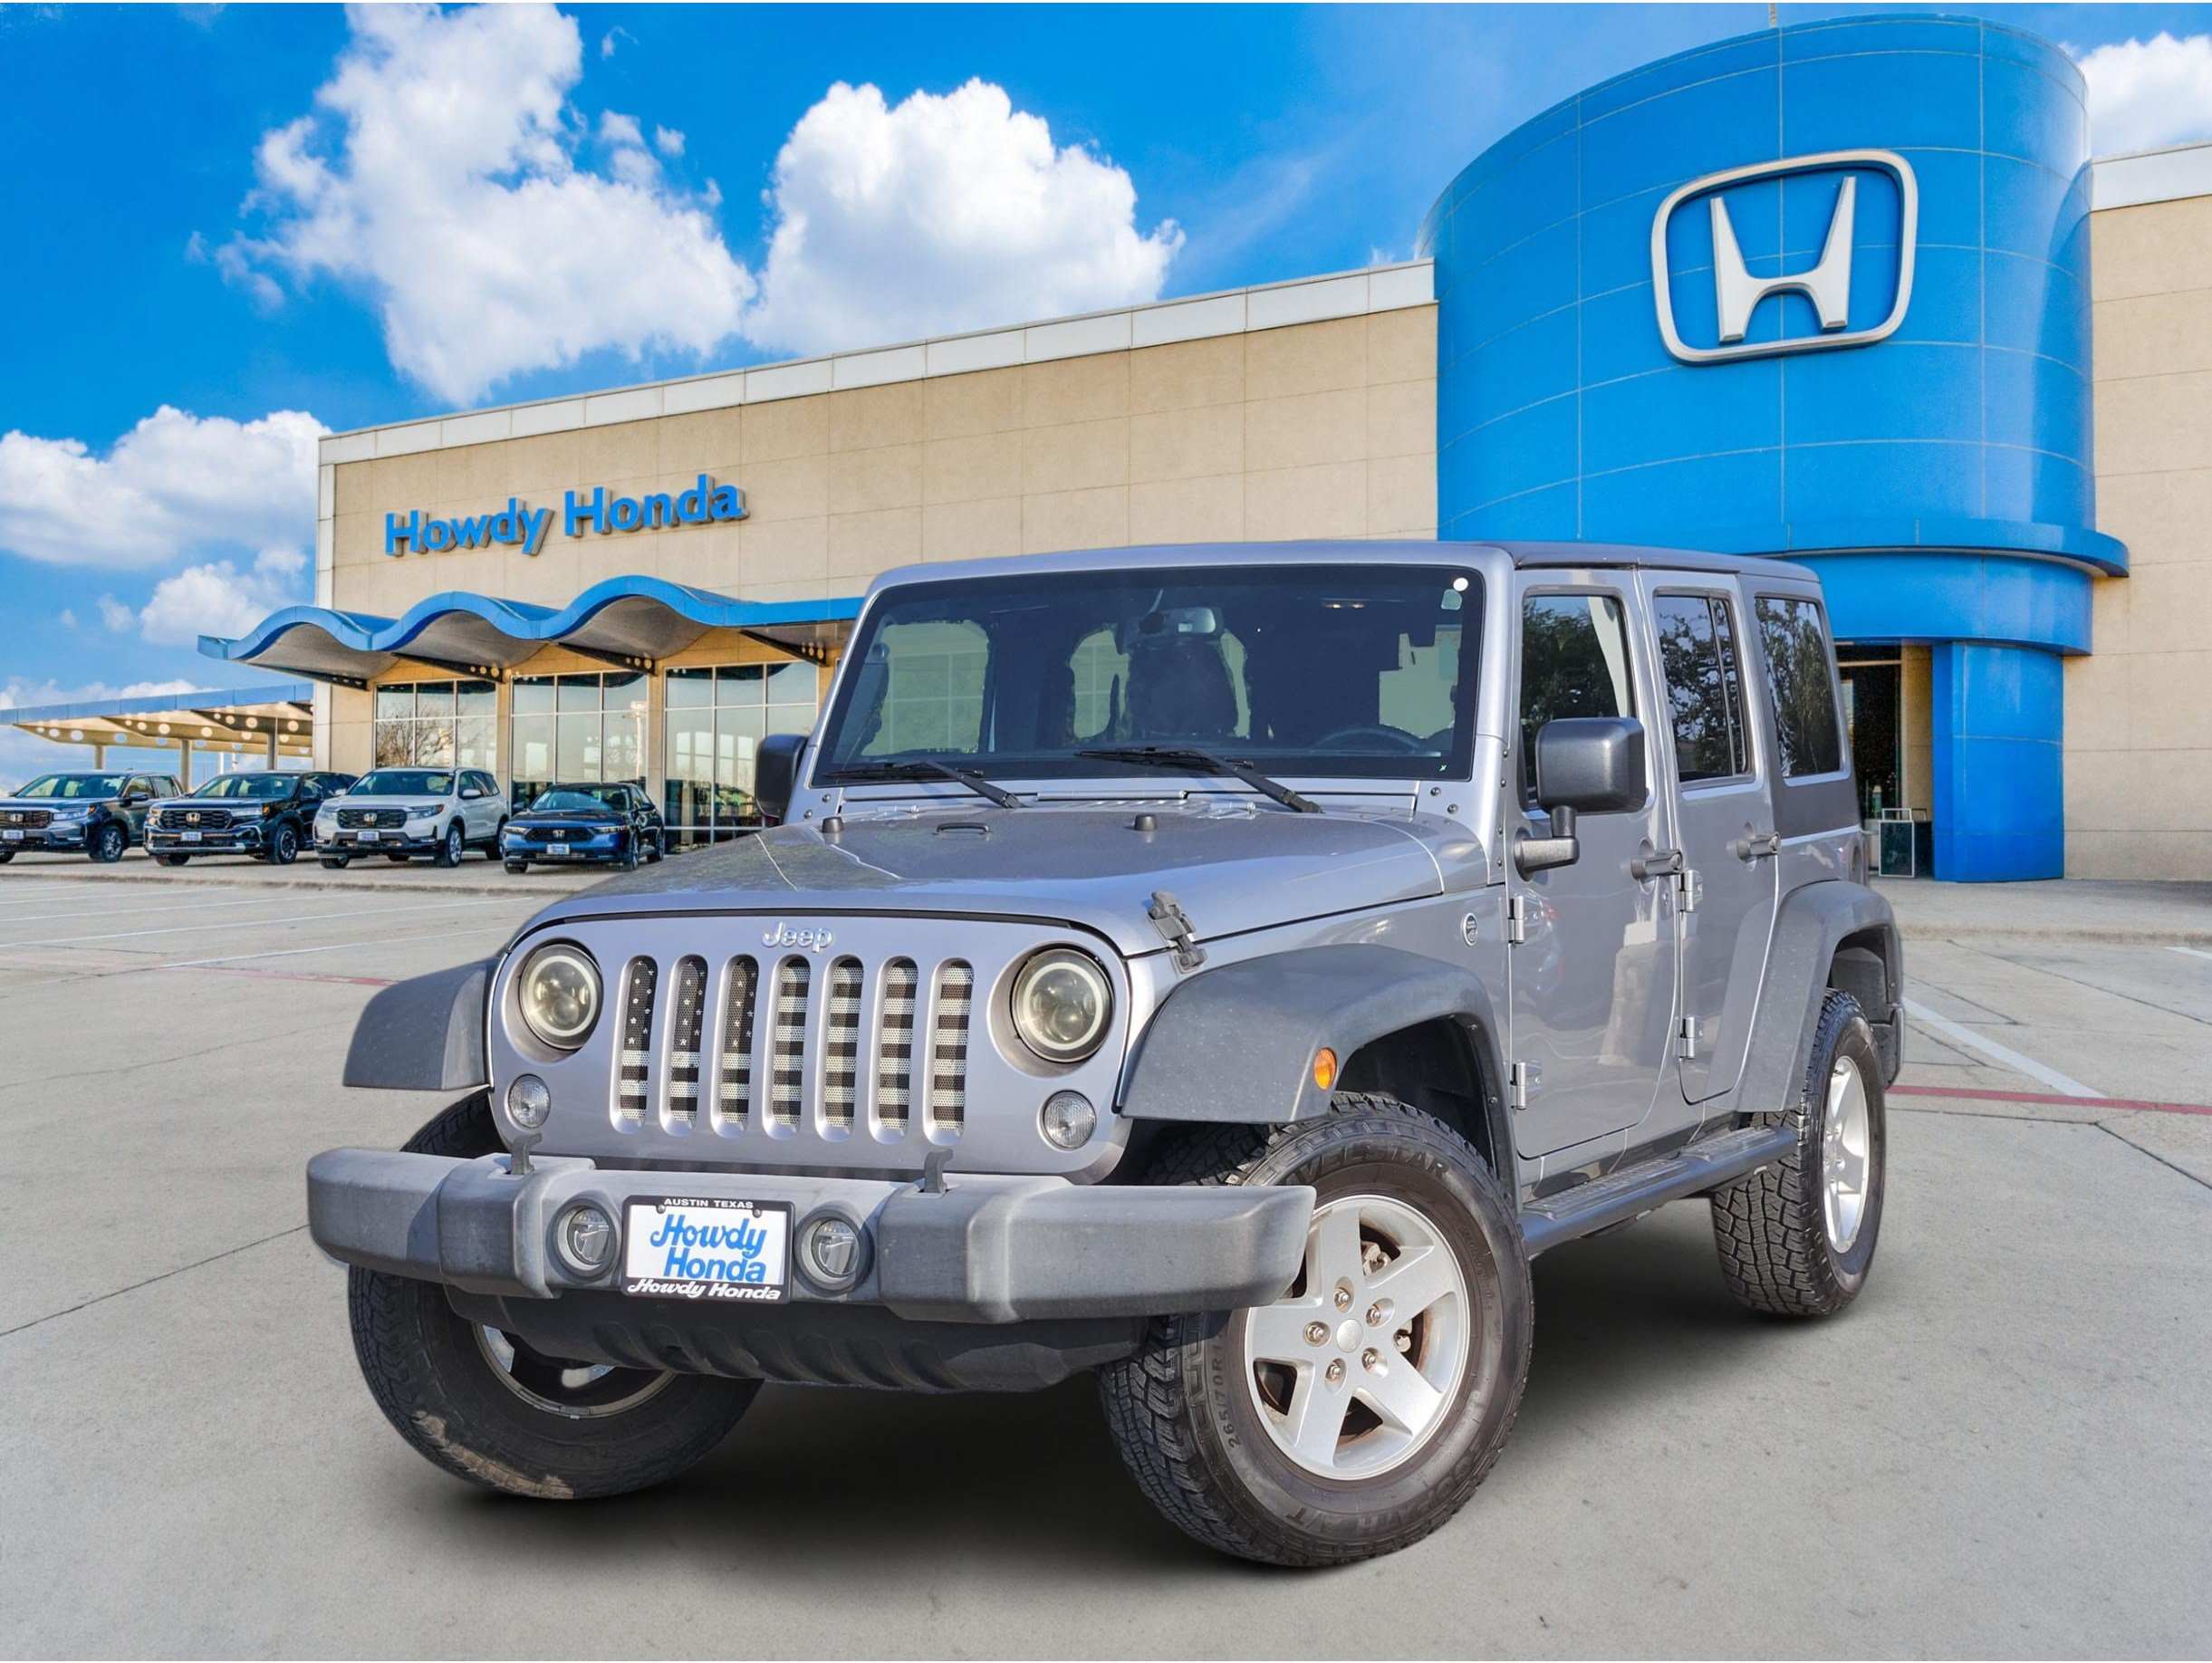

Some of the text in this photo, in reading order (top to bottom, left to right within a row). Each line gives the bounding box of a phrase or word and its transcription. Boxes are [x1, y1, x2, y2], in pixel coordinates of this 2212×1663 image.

[385, 473, 749, 557] Howdy Honda
[761, 921, 833, 953] Jeep
[663, 1197, 755, 1209] AUSTIN TEXAS
[649, 1214, 768, 1259] Howdy
[663, 1246, 766, 1283] Honda
[627, 1278, 782, 1301] Howdy Honda
